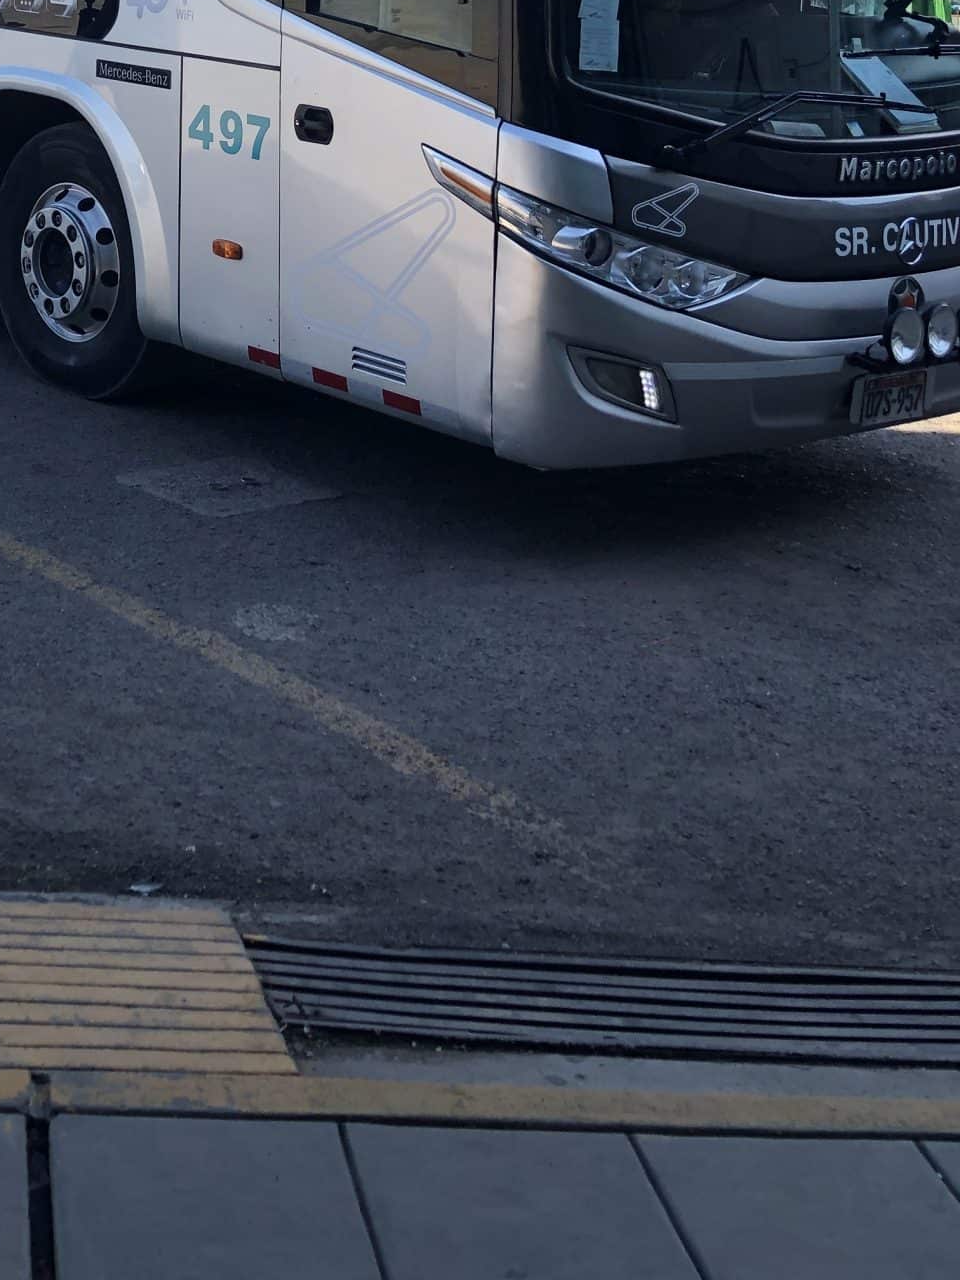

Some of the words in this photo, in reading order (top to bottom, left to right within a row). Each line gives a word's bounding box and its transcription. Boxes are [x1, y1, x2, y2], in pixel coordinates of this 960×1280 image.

[175, 8, 194, 22] WiFi
[98, 61, 169, 87] Mercedes-Benz
[188, 104, 271, 160] 497
[839, 152, 957, 181] Marcopolo
[834, 225, 877, 257] SR.
